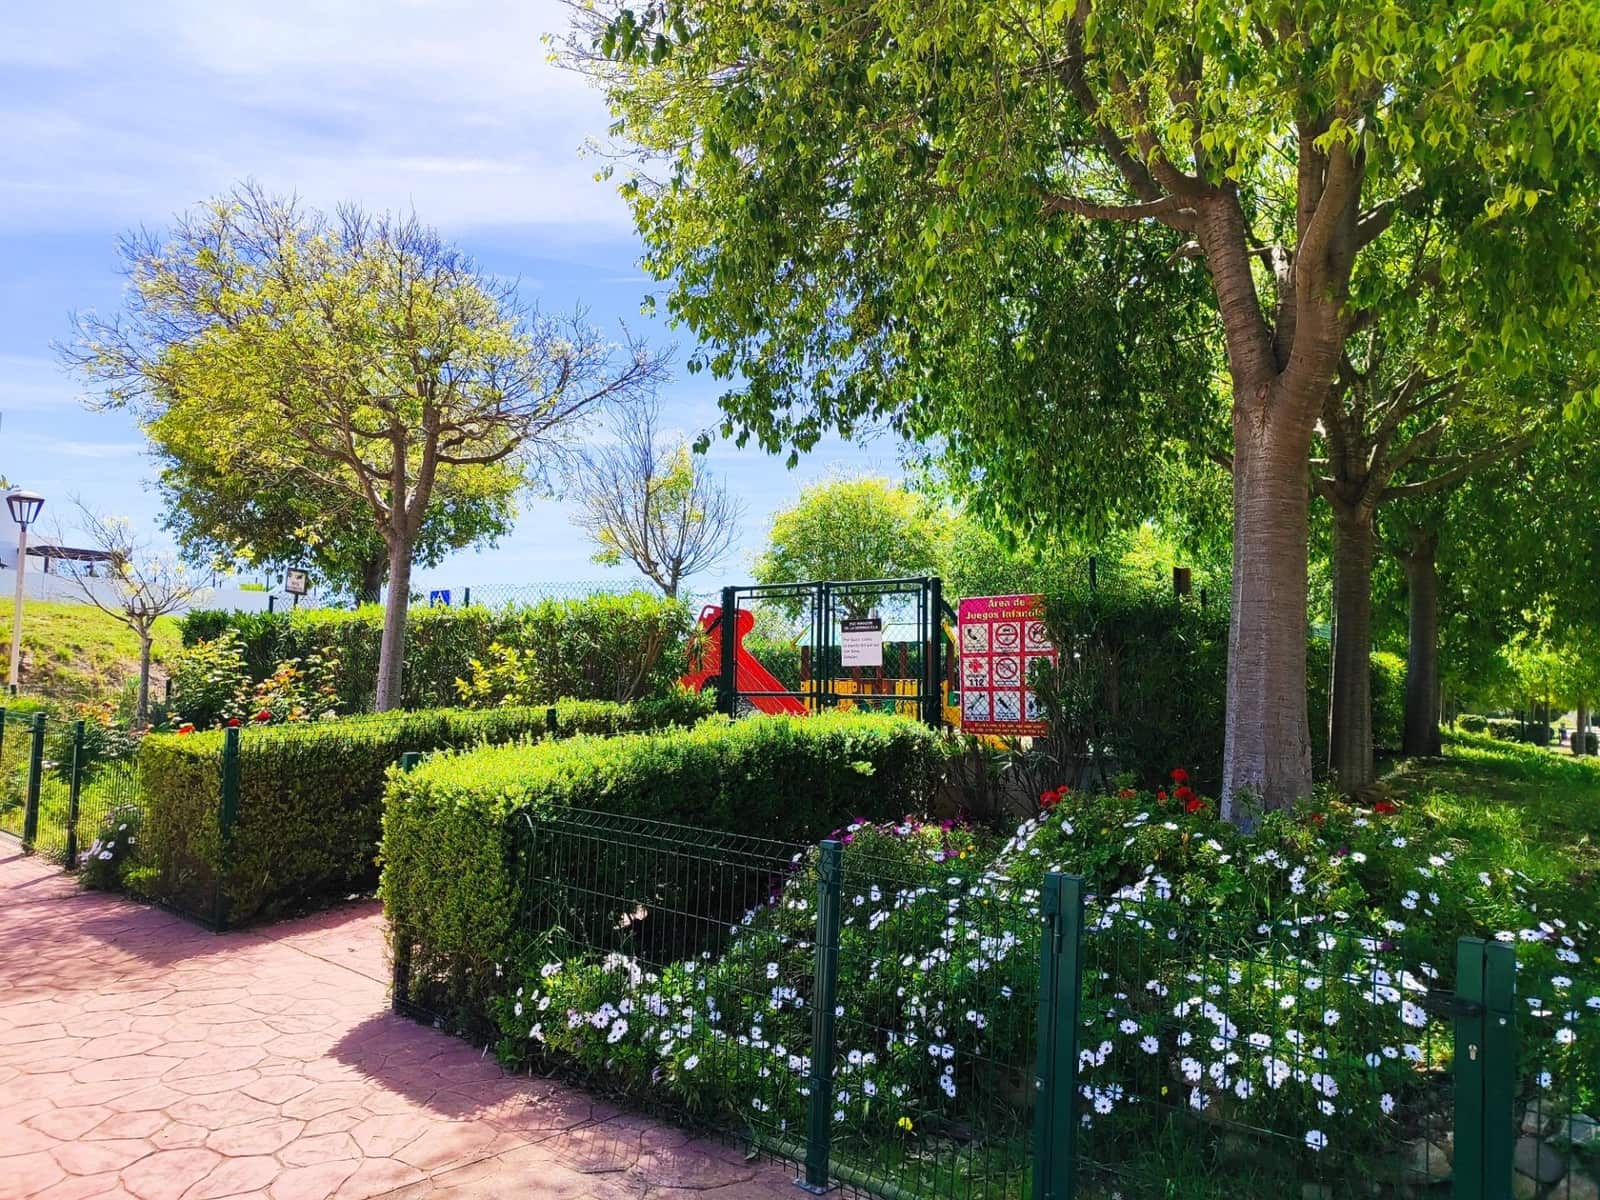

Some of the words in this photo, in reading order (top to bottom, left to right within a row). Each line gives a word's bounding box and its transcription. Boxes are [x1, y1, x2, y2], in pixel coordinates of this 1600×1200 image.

[1013, 597, 1025, 607] de
[966, 611, 999, 620] Juegos
[968, 678, 985, 686] 112
